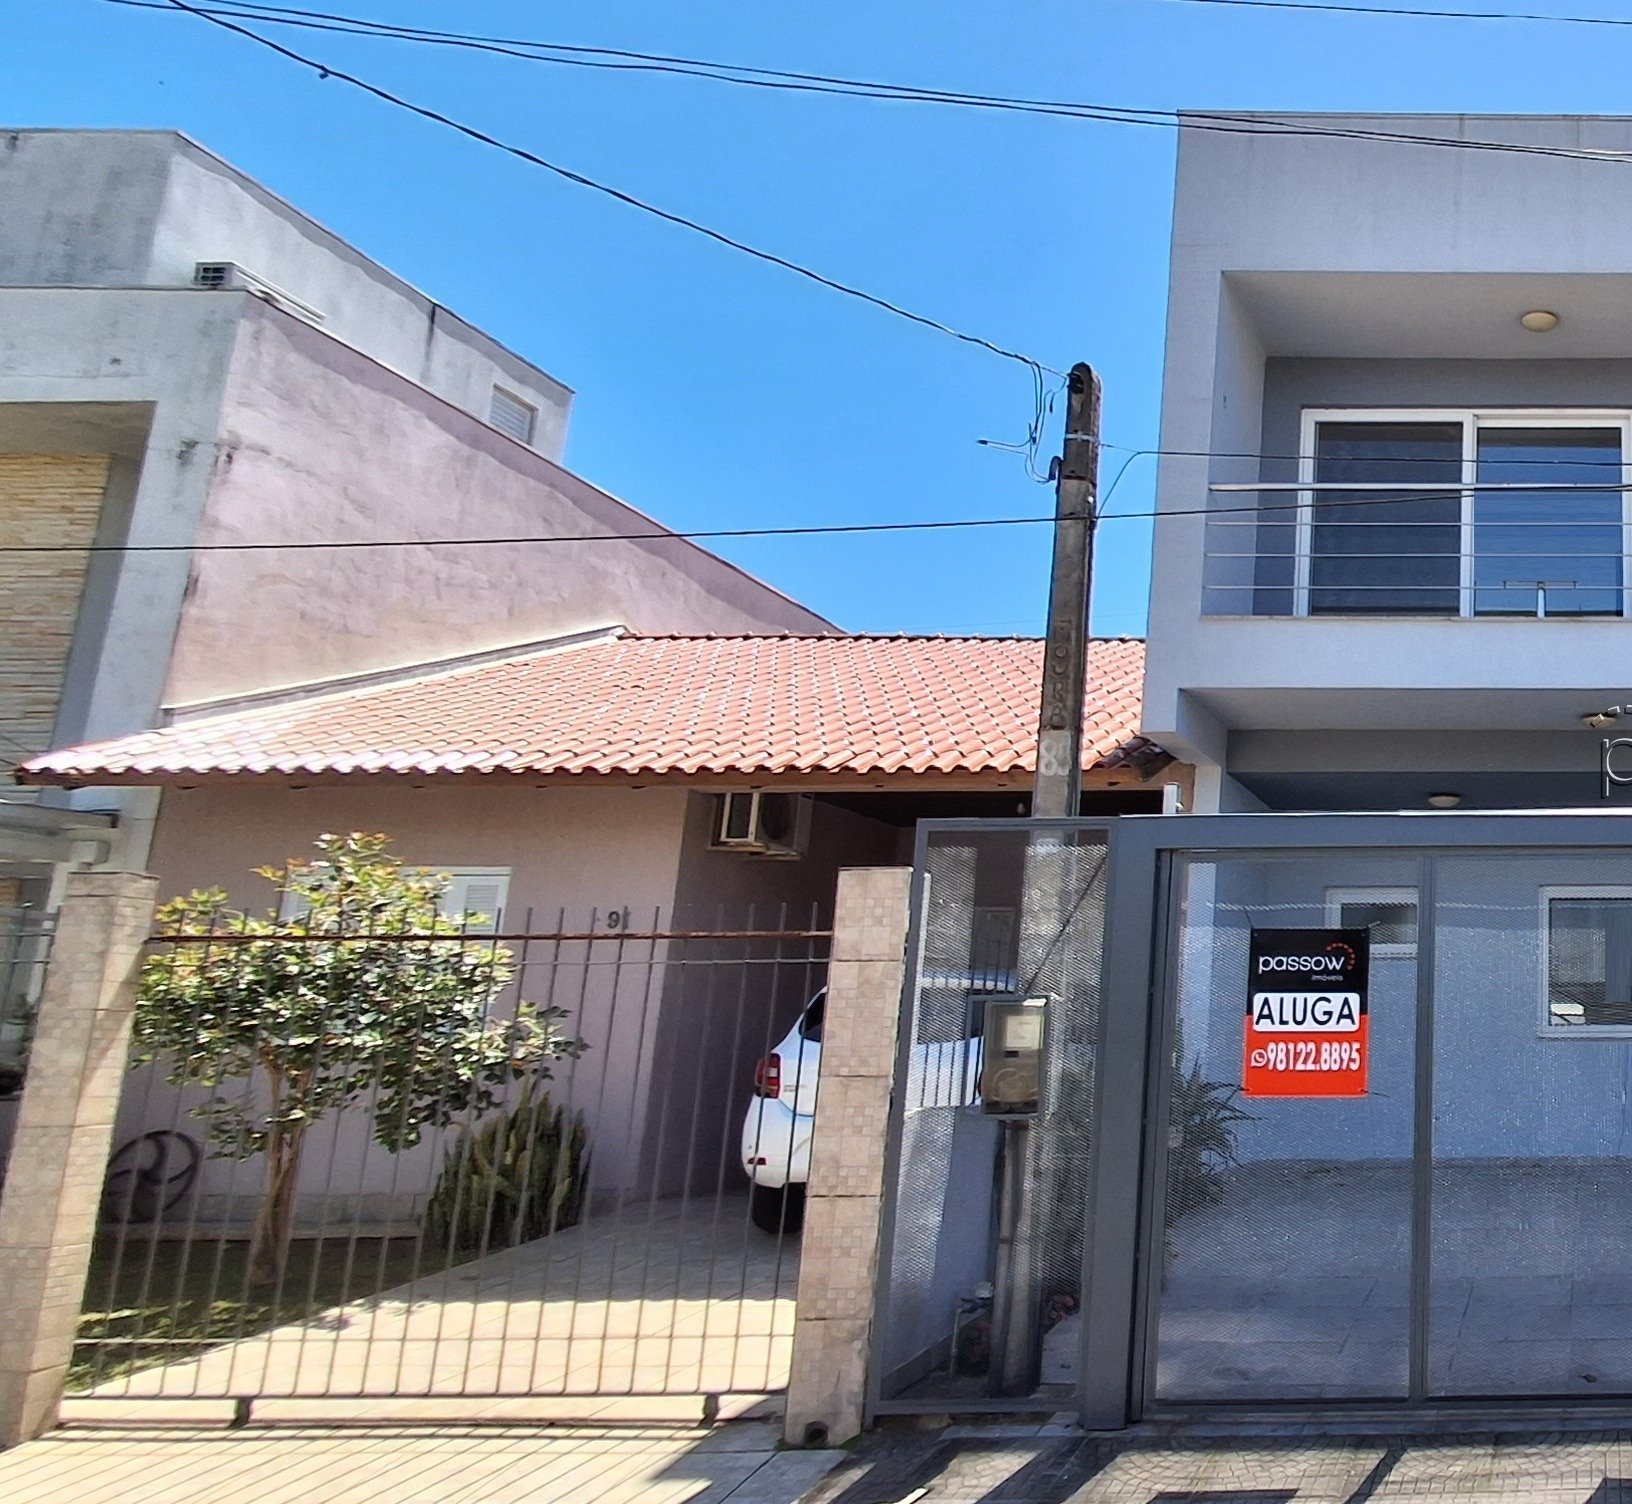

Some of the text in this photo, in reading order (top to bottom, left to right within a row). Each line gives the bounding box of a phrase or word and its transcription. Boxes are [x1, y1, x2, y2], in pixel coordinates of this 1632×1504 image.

[1258, 956, 1345, 975] passow
[1255, 996, 1357, 1026] ALUGA
[1267, 1041, 1361, 1072] 98122.8895
